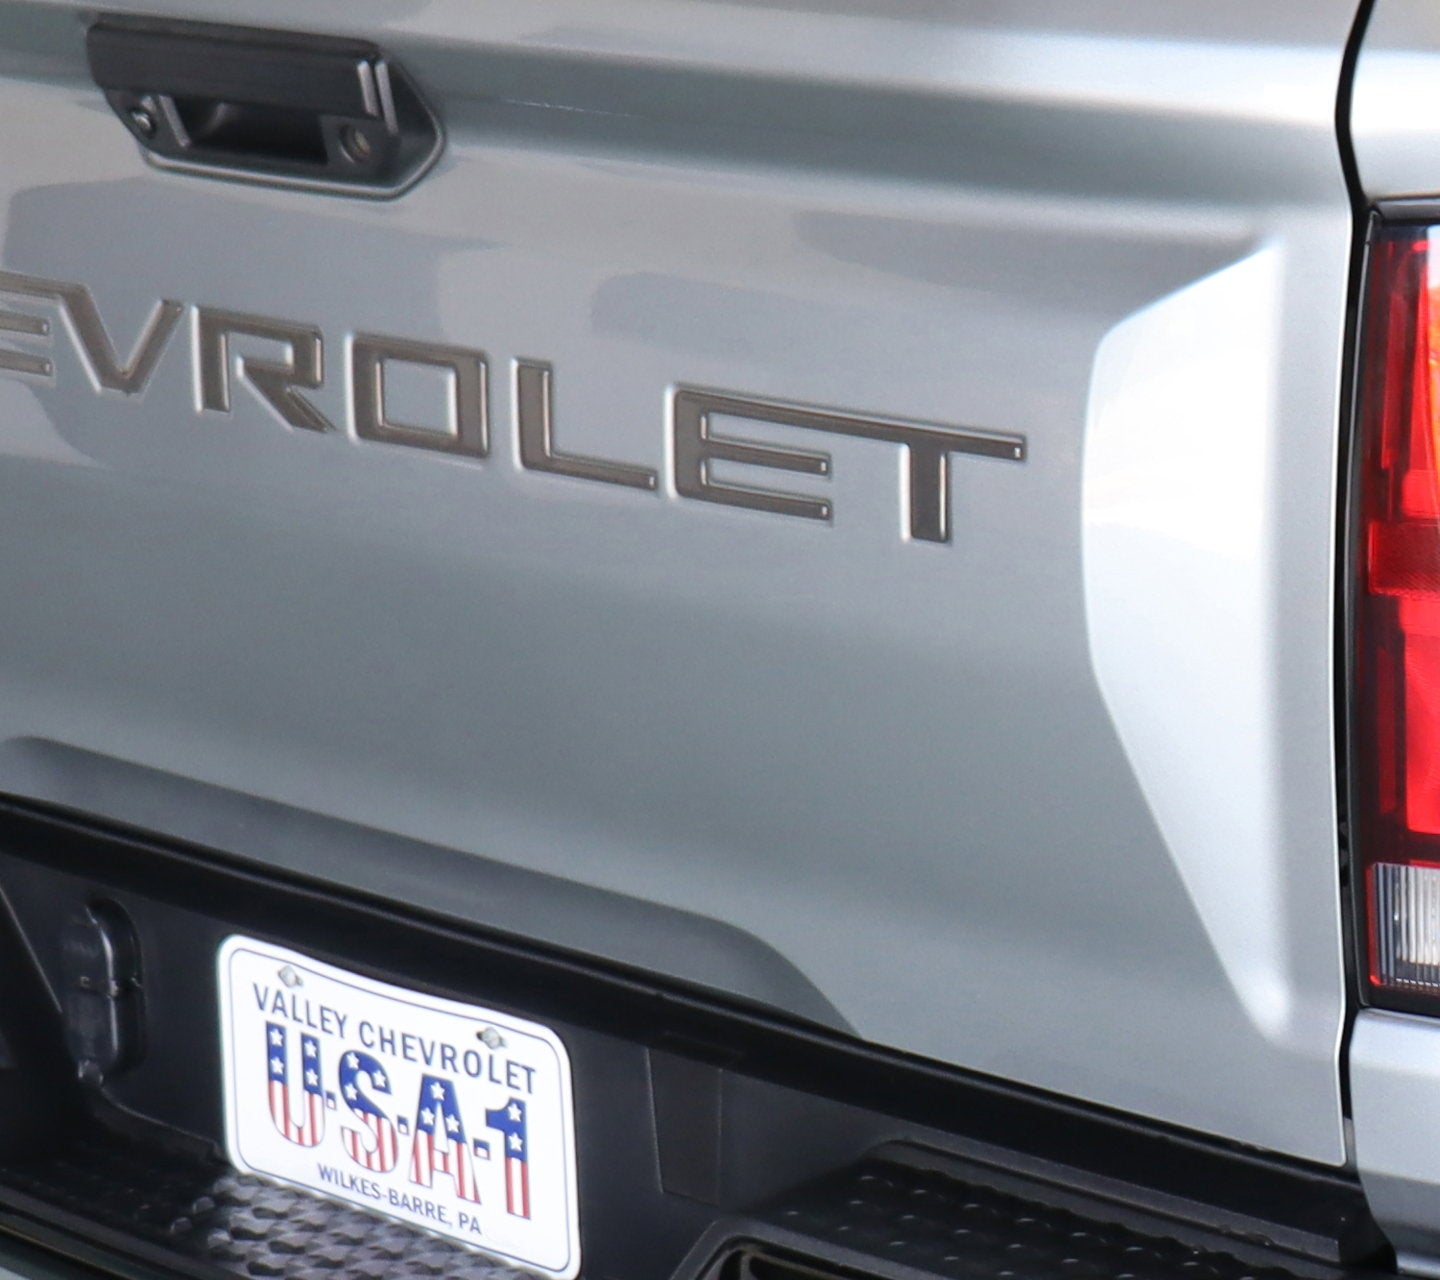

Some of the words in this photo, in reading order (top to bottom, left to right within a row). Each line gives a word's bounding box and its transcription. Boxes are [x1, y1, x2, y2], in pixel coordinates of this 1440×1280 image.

[252, 981, 348, 1039] VALLEY
[358, 1020, 537, 1095] CHEVROLET
[458, 1212, 483, 1236] PA
